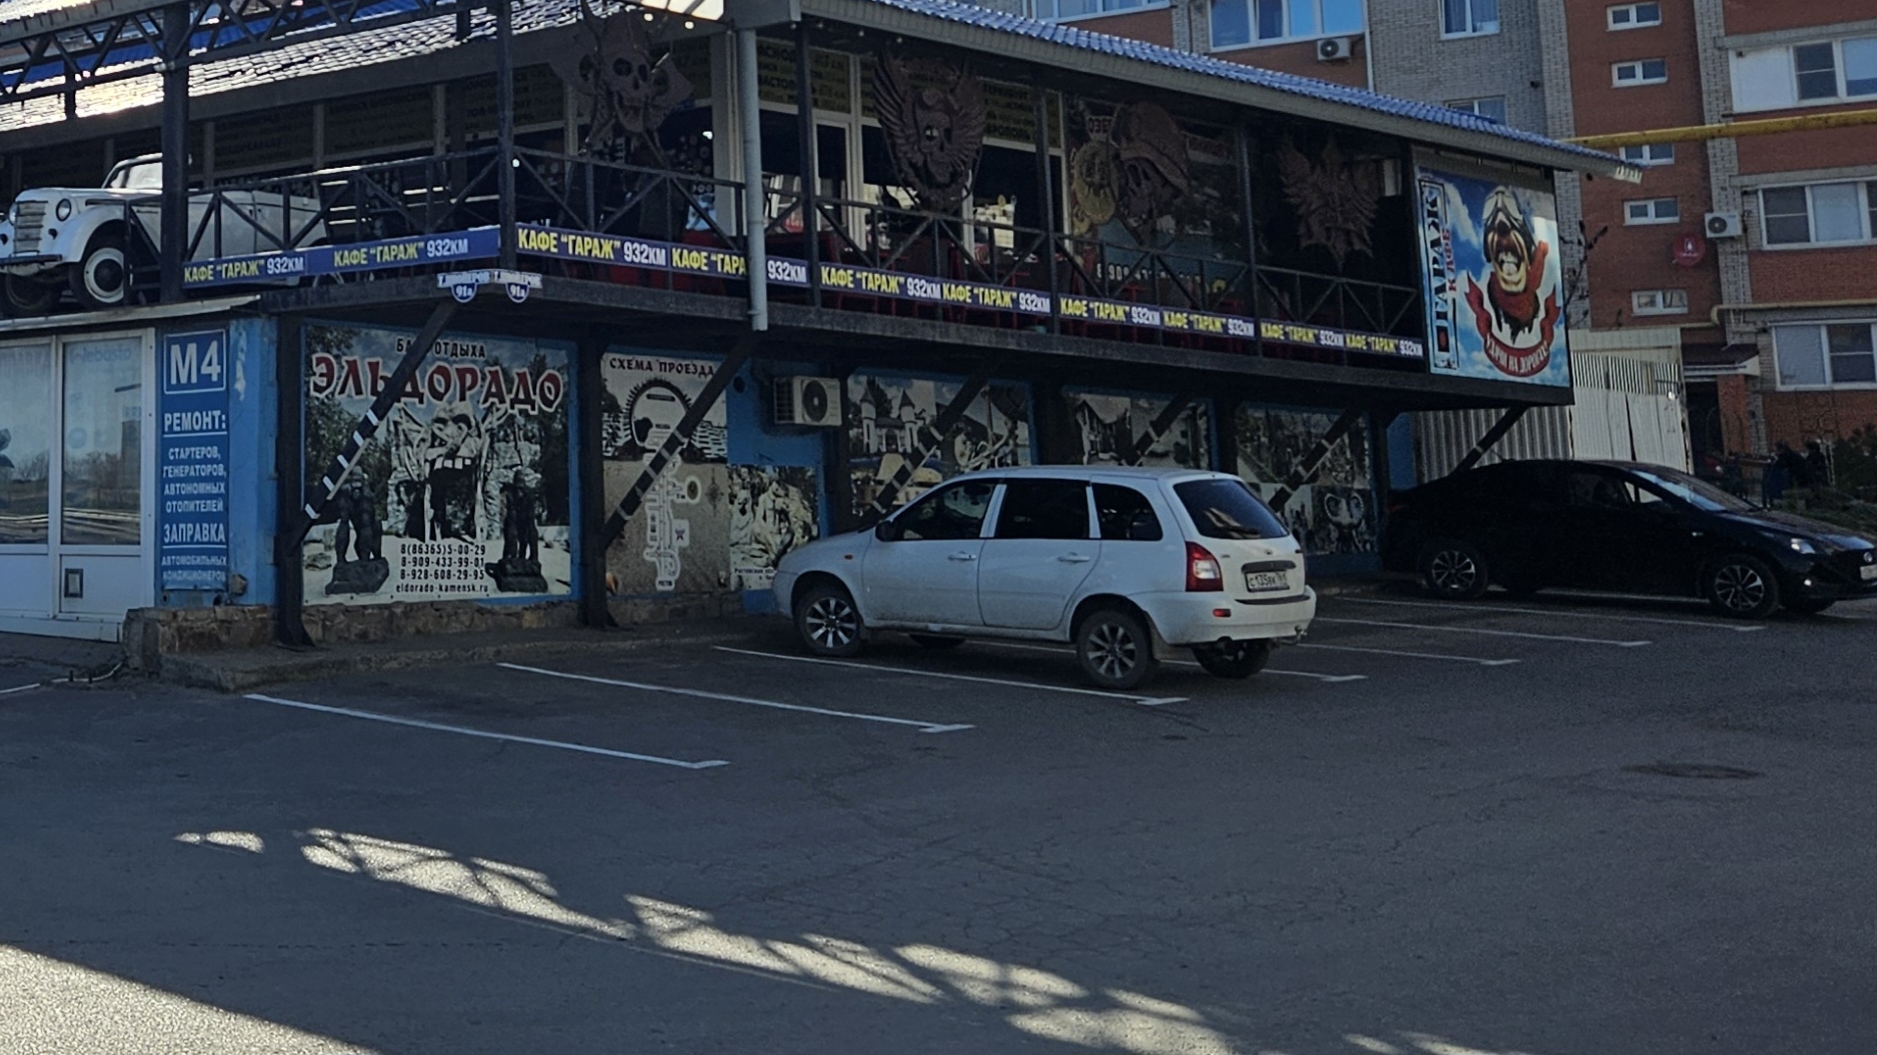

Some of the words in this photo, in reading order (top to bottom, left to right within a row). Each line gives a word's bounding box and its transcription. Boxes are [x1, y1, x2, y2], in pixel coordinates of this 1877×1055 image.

[518, 228, 558, 253] КАФЕ
[334, 247, 368, 267] КАФЕ
[672, 247, 709, 271] КАФЕ
[710, 254, 746, 275] “ГАРА
[184, 264, 214, 283] КАФЕ
[821, 266, 854, 287] КАФЕ
[942, 283, 972, 303] КАФЕ
[1060, 298, 1088, 317] КАФЕ
[1163, 311, 1188, 329] КАФЕ
[1260, 322, 1284, 340] КАФЕ
[434, 341, 485, 357] ОТДЫХА
[170, 340, 221, 385] М4
[609, 357, 653, 372] СХЕМА
[659, 361, 714, 378] ПРОЕЗДА
[310, 353, 564, 414] ЭЛЬДОРАДО
[163, 410, 226, 432] РЕМОНТ:
[168, 445, 221, 460] СТАРТЕРОВ,
[163, 463, 226, 478] ГЕНЕРАТОРОВ,
[164, 481, 225, 496] АВТОНОМНЫХ
[165, 497, 223, 514] ОТОПИТЕЛЕЙ
[163, 522, 225, 543] ЗАПРАВКА
[401, 556, 485, 568] 8-909-433-99-01
[396, 584, 488, 593] eldorado-kamensk.ru
